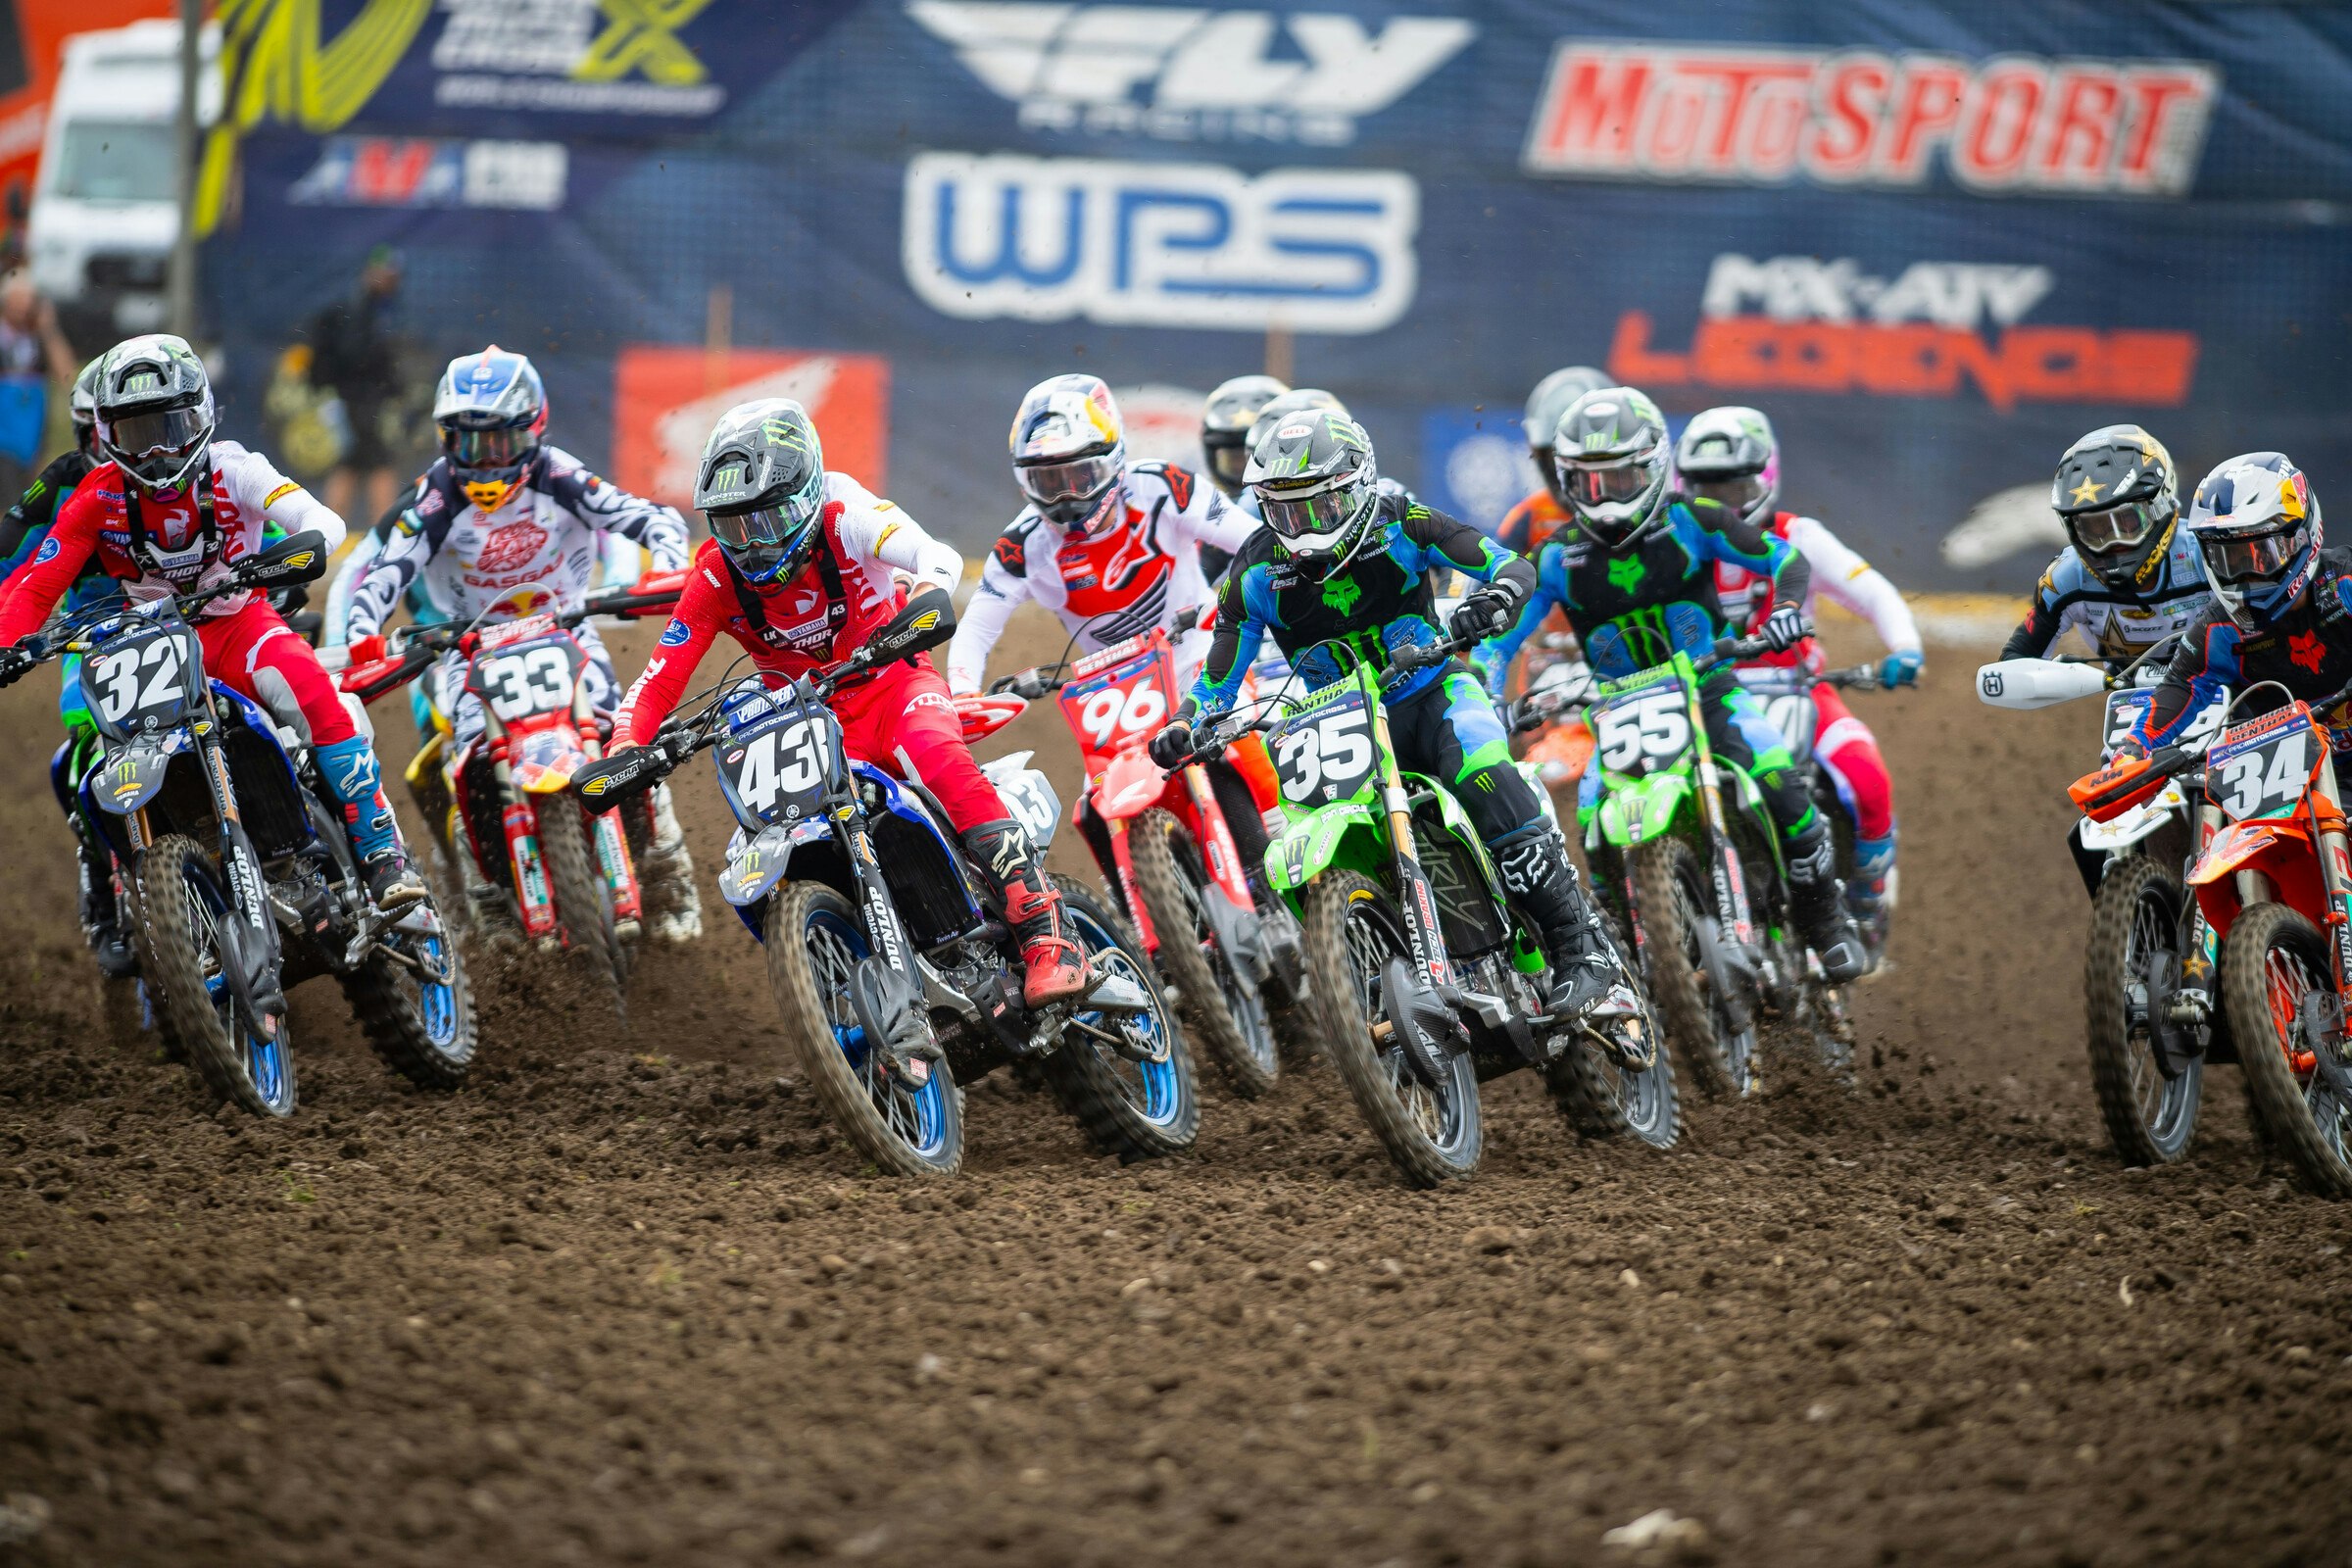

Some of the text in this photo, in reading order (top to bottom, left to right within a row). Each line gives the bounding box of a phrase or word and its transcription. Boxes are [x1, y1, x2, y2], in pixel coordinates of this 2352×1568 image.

[919, 167, 1401, 316] WPS
[164, 564, 205, 579] THOR
[206, 541, 220, 554] 32
[702, 568, 721, 589] THOR
[797, 618, 827, 636] YAMAHA
[830, 604, 846, 616] 43
[763, 630, 777, 642] LK
[792, 628, 833, 649] THOR
[889, 625, 921, 649] CYCRA
[95, 634, 188, 722] 32
[483, 646, 574, 721] 33
[1082, 672, 1166, 752] 96
[1599, 691, 1690, 771] 55
[604, 764, 640, 788] CYCRA
[736, 717, 831, 813] 43
[1278, 708, 1372, 802] 35
[2089, 768, 2124, 788] KTM
[2222, 732, 2311, 821] 34
[232, 845, 265, 930] DUNLOP
[1414, 879, 1435, 930] BRAKING
[868, 886, 905, 972] DUNLOP
[1403, 900, 1432, 994] DUNLOP
[2334, 900, 2352, 971] DUNLP
[1579, 997, 1596, 1016] FOX
[1383, 1032, 1396, 1044] 35
